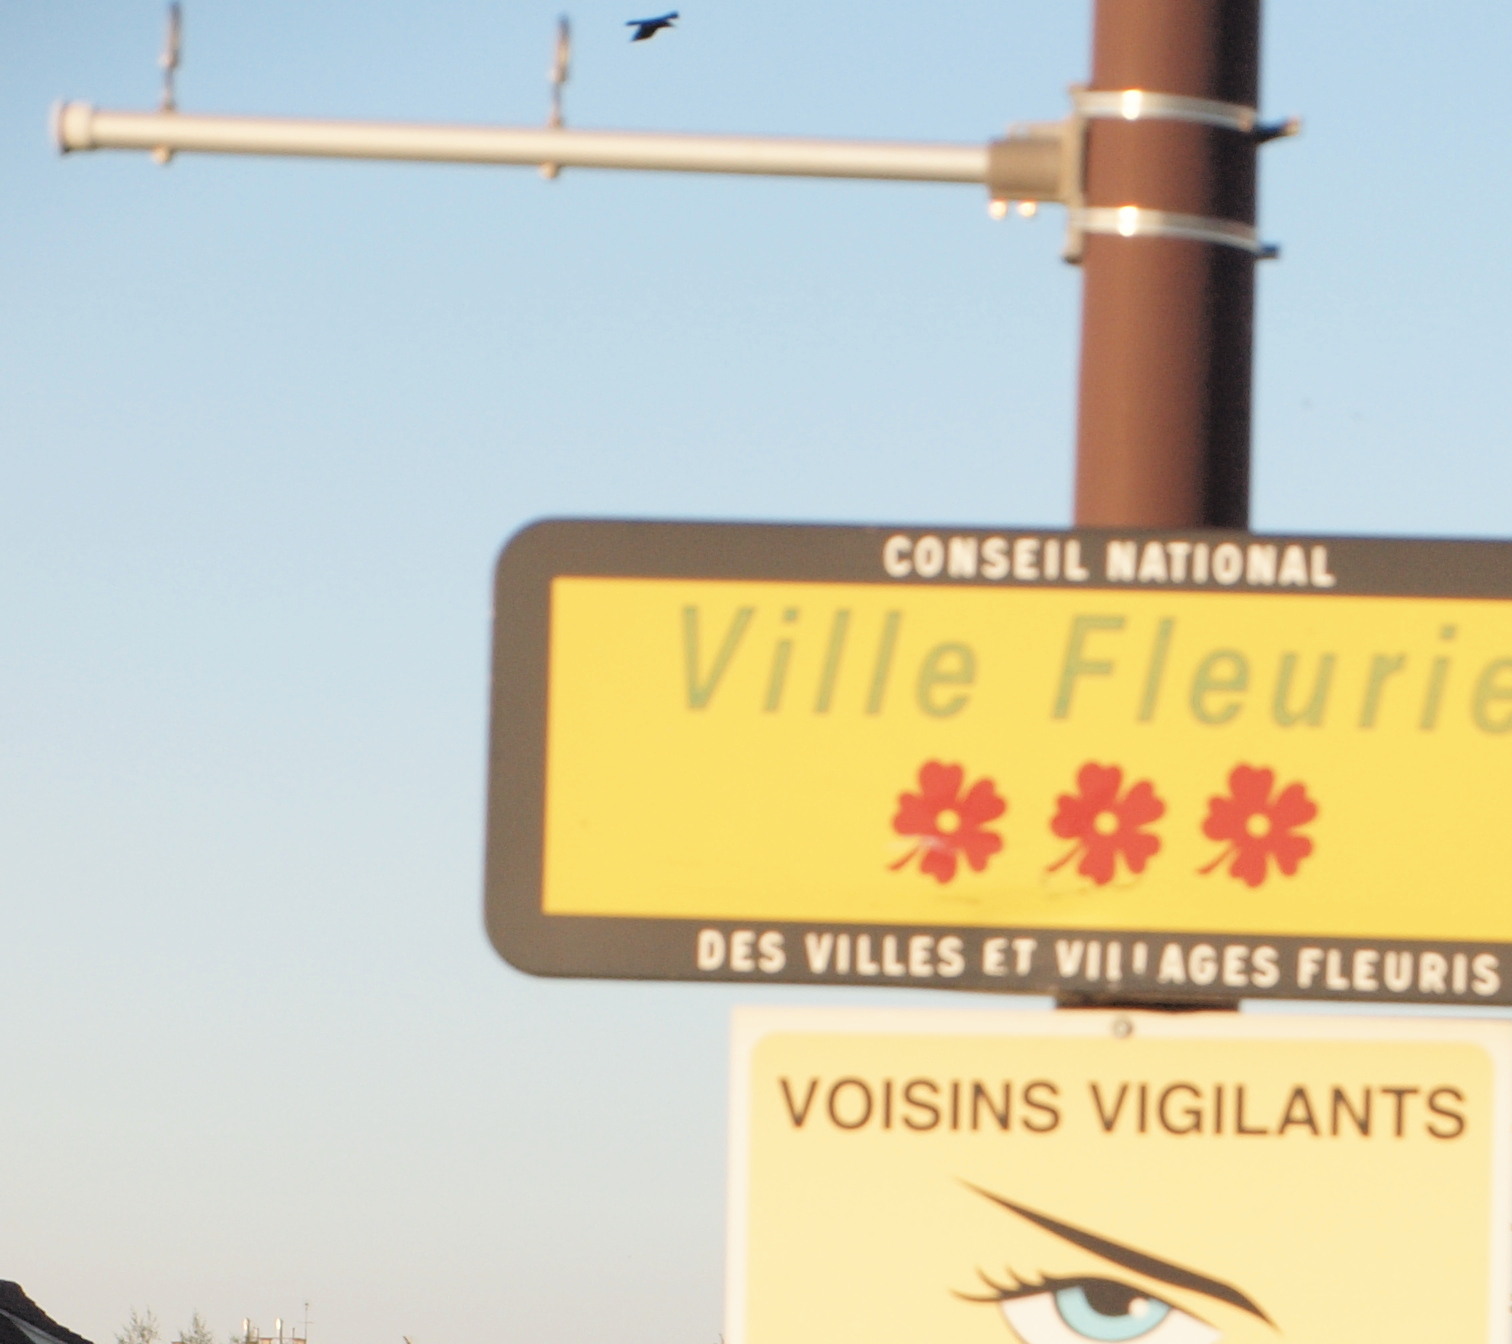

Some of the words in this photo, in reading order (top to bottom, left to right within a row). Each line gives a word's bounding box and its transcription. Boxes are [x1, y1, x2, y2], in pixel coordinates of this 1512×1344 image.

[884, 535, 1089, 581] CONSEIL
[1106, 541, 1336, 588] NATIONAL
[681, 604, 977, 718] Ville
[697, 929, 786, 973] DES
[805, 933, 965, 977] VILLES
[983, 937, 1037, 976] ET
[1297, 947, 1500, 996] FLEURIS
[780, 1077, 1061, 1134] VOISINS
[1090, 1082, 1466, 1140] VIGILANTS
